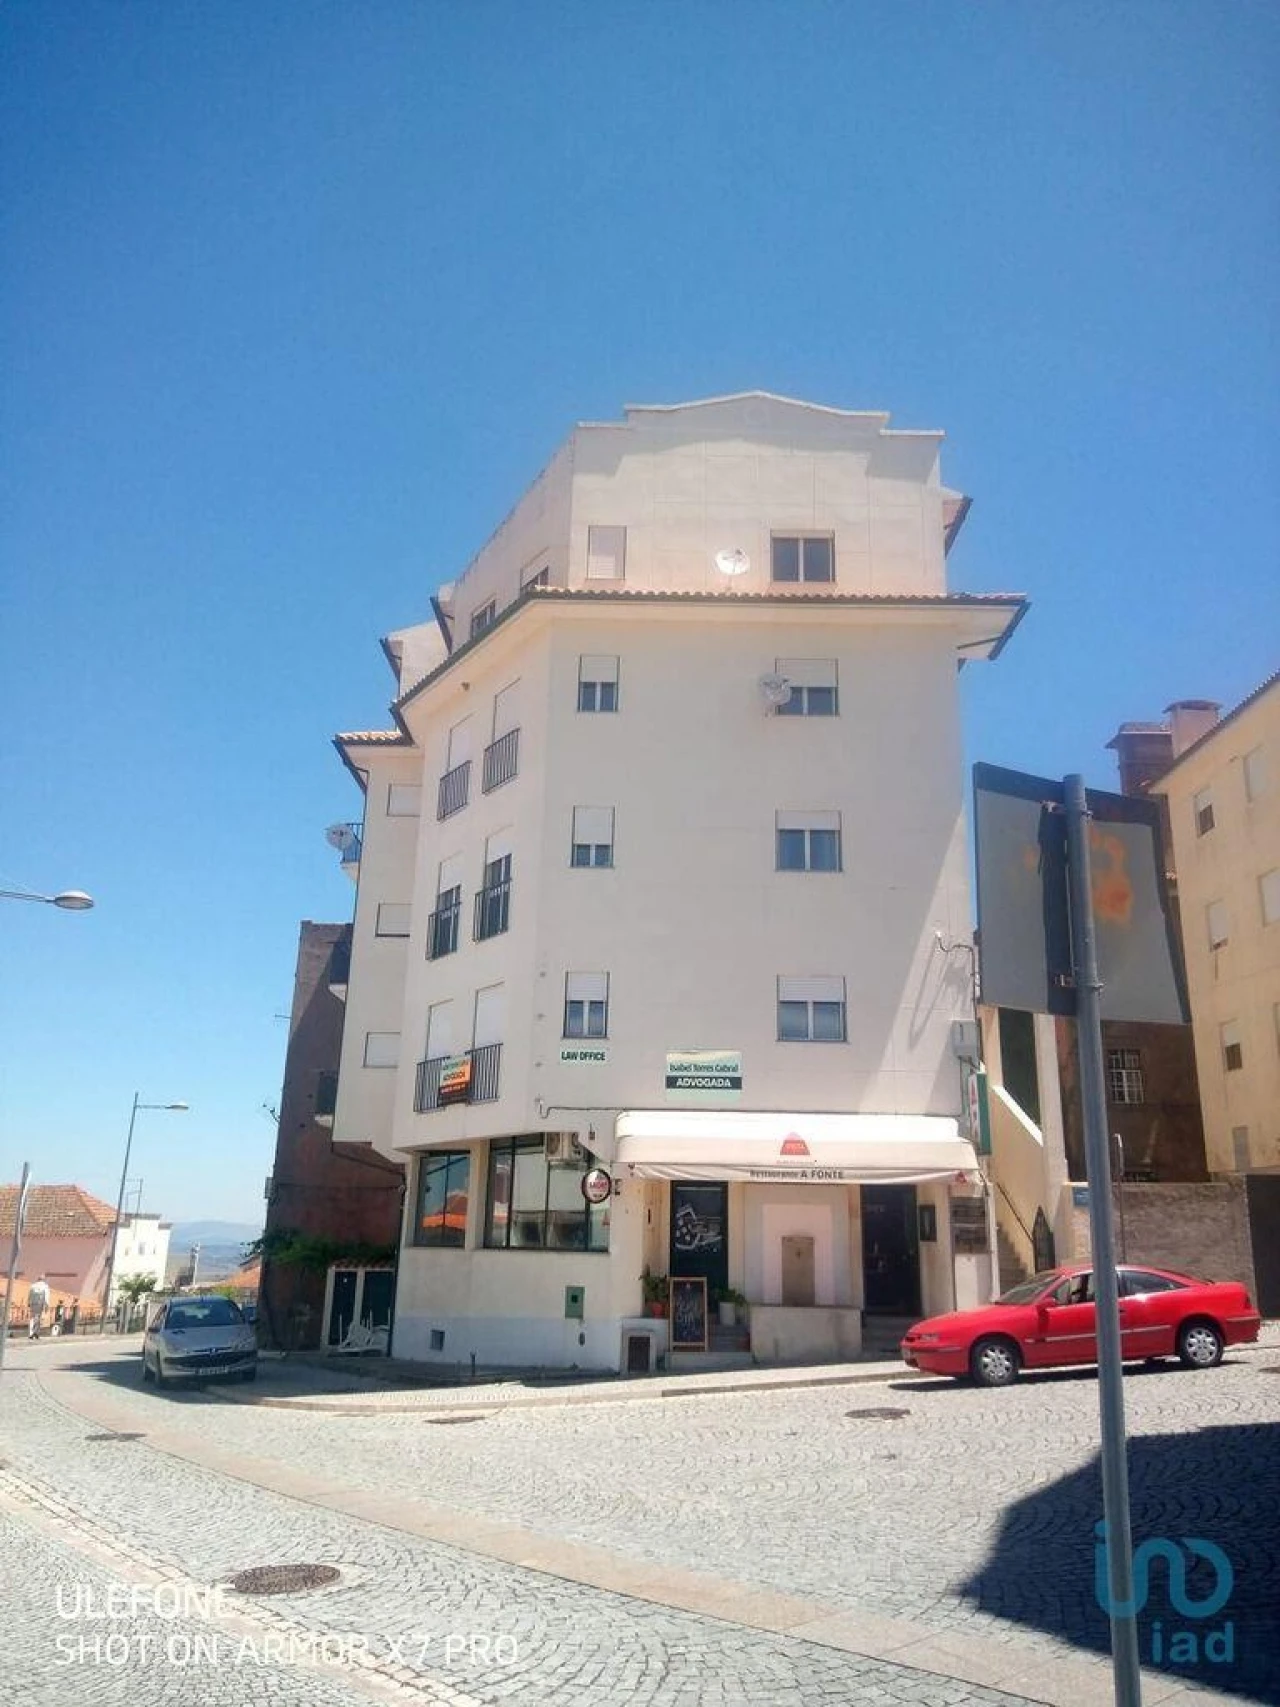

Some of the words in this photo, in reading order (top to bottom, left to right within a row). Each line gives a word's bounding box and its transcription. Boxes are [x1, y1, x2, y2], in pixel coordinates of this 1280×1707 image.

[561, 1051, 579, 1061] LAW
[580, 1051, 606, 1061] OFFICE
[676, 1078, 732, 1088] ADVOGADA
[811, 1170, 844, 1179] FONTE
